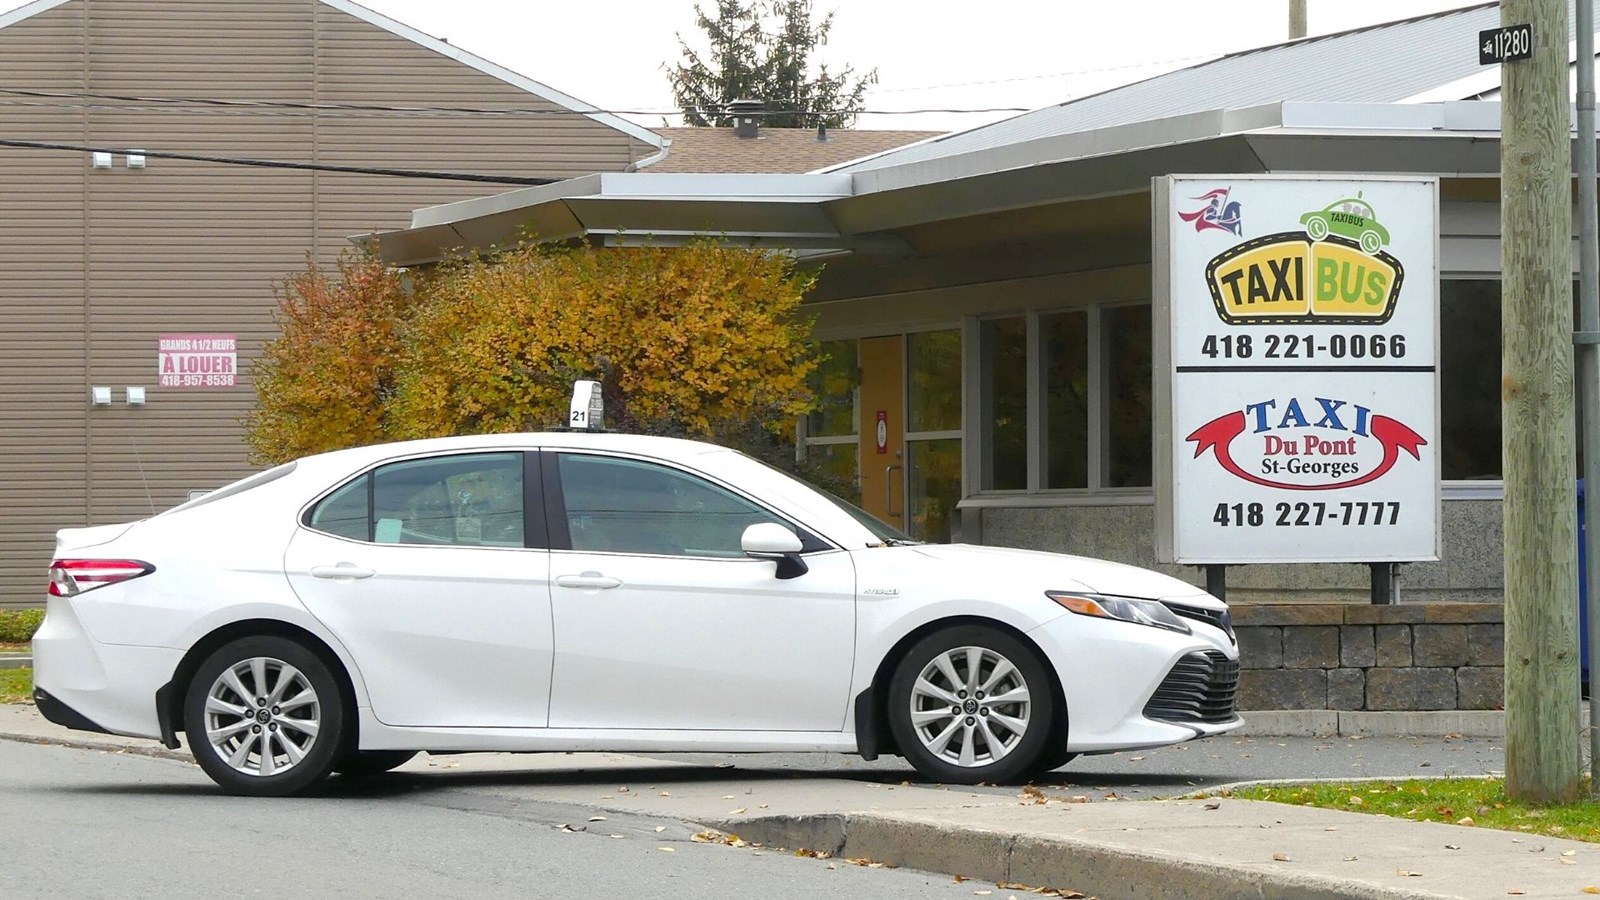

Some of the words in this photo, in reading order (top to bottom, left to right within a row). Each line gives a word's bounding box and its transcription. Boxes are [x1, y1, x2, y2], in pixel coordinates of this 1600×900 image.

[1495, 28, 1529, 58] 11280
[1331, 213, 1364, 227] TAXIBUS
[1221, 257, 1304, 306] TAXI
[1317, 258, 1386, 306] BUS
[161, 339, 191, 351] GRANDS
[212, 339, 235, 351] NEUFS
[1201, 334, 1253, 359] 418
[1264, 334, 1406, 359] 221-0066
[163, 353, 175, 373] À
[179, 356, 233, 373] LOUER
[572, 410, 585, 422] 21
[1246, 397, 1371, 438] TAXI
[1263, 435, 1298, 456] Du
[1303, 435, 1357, 456] Pont
[1261, 458, 1359, 478] St-Georges
[1213, 502, 1265, 527] 418
[1275, 501, 1401, 527] 227-7777
